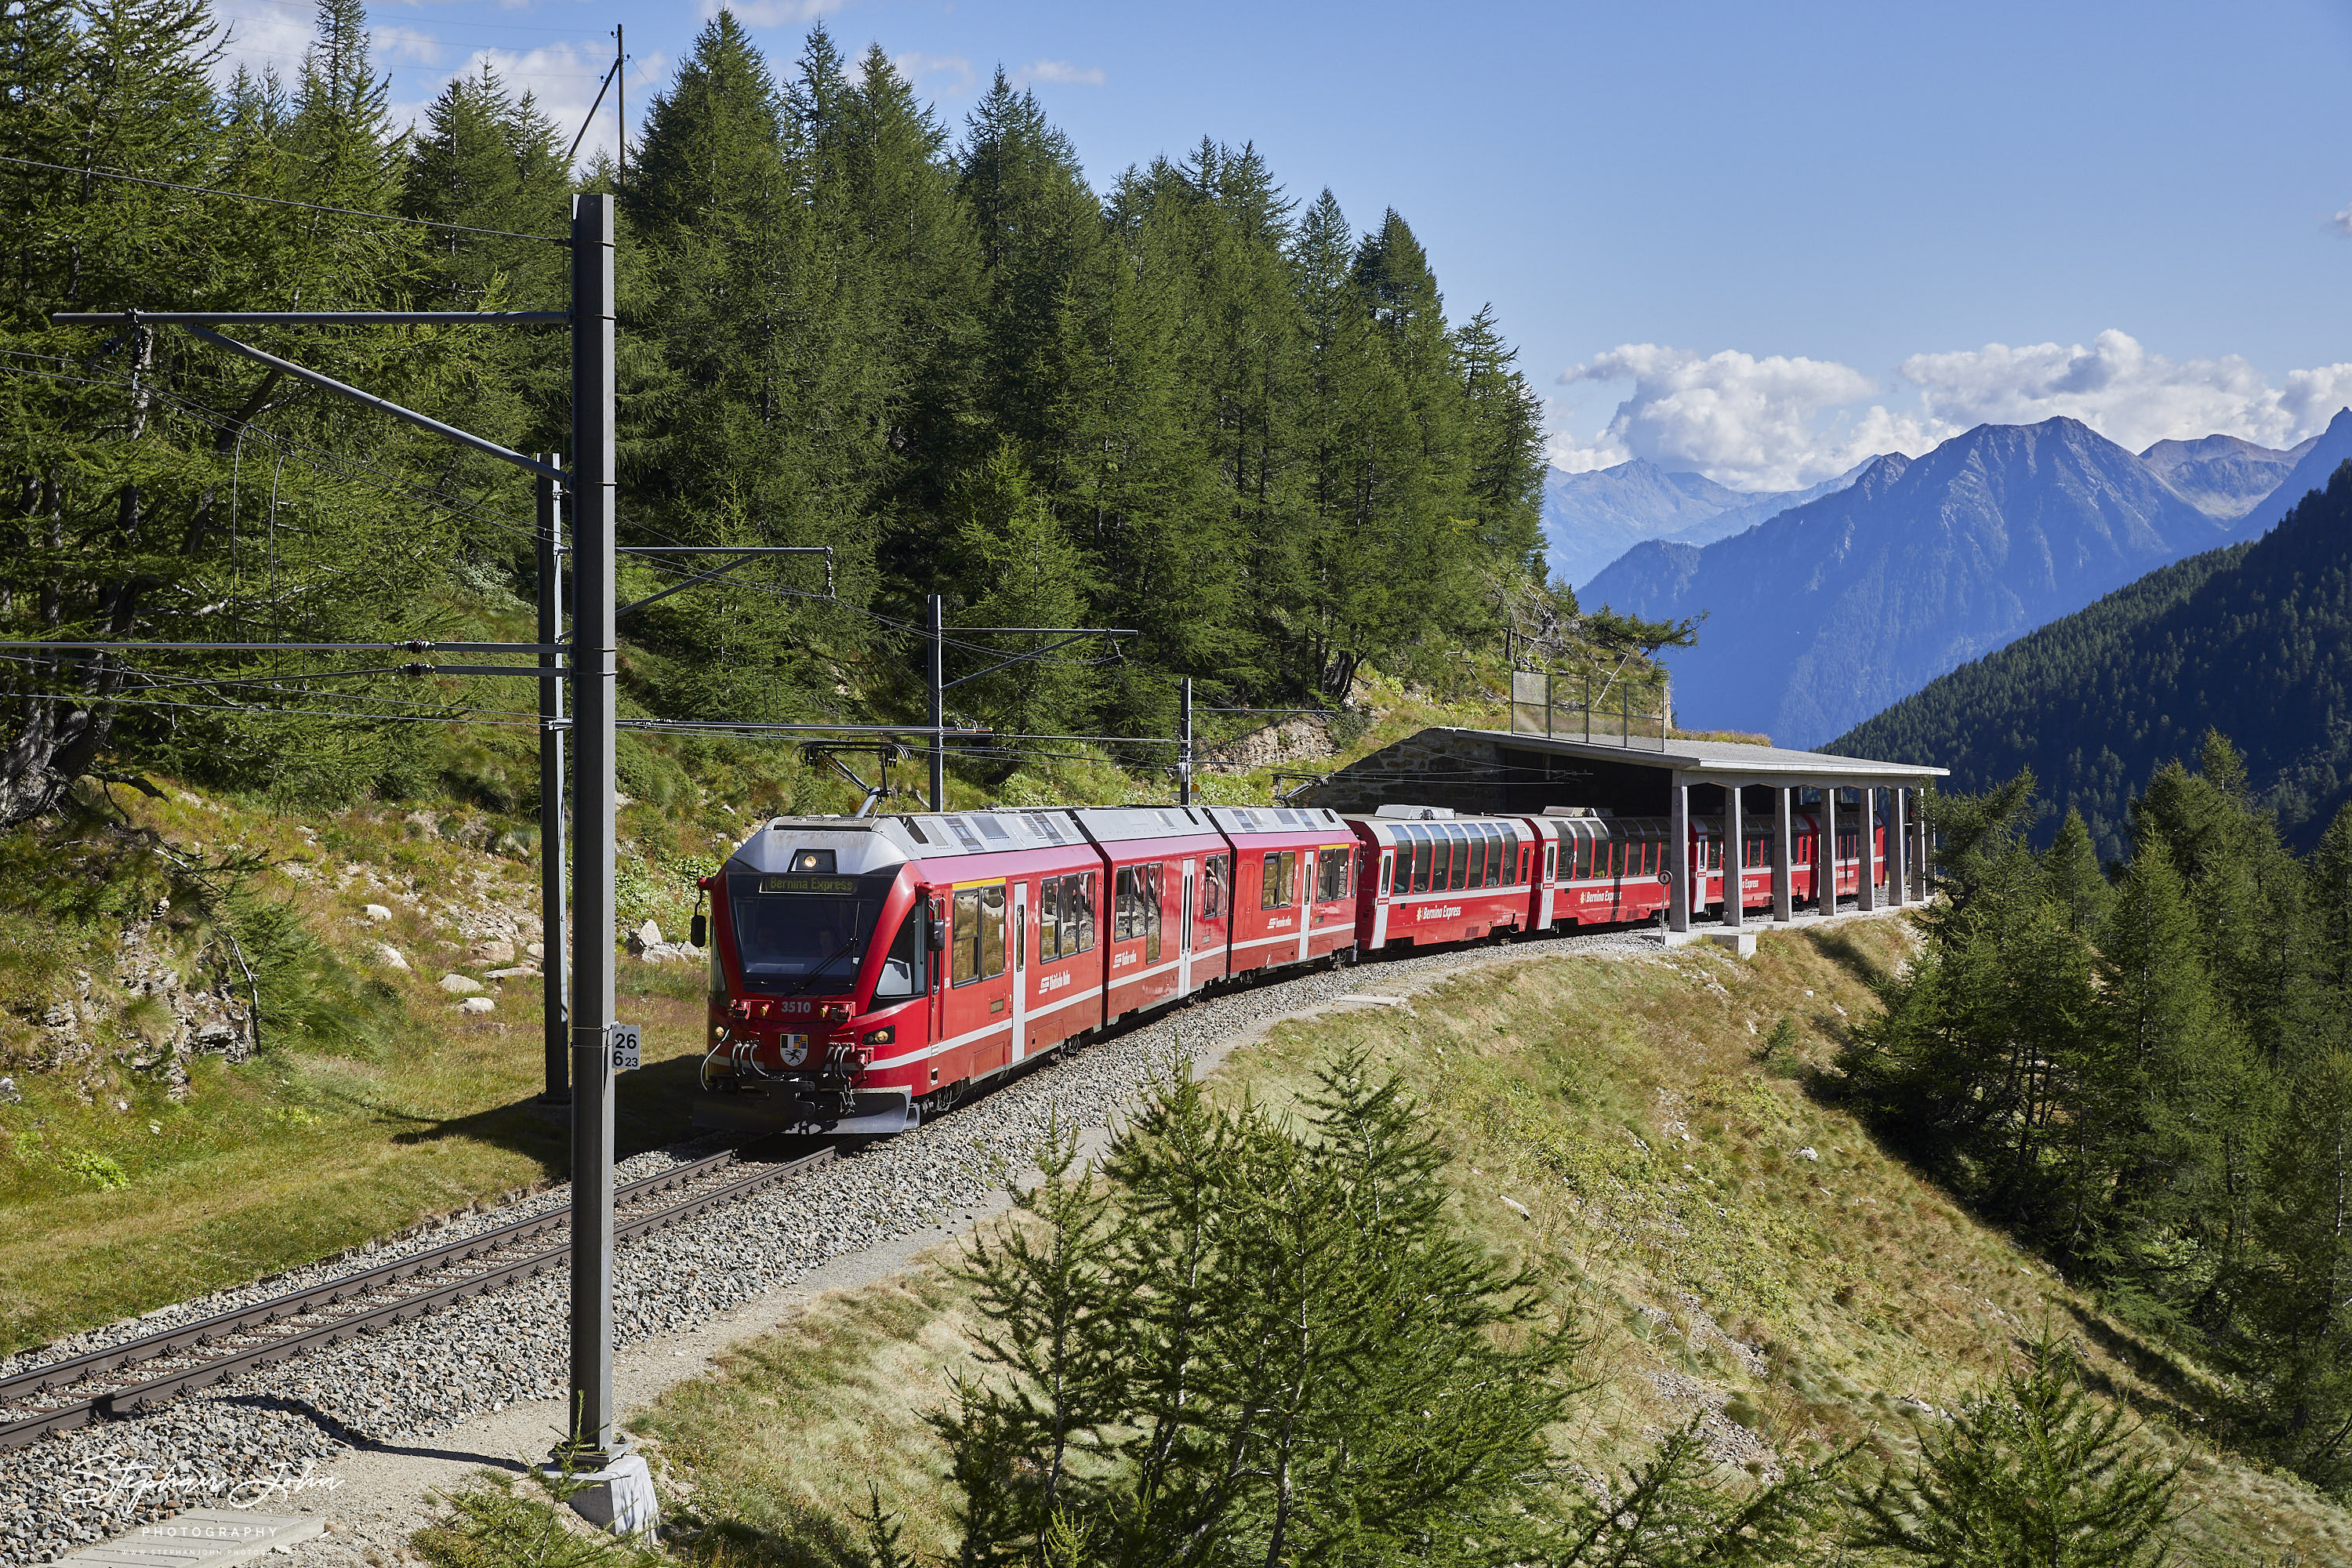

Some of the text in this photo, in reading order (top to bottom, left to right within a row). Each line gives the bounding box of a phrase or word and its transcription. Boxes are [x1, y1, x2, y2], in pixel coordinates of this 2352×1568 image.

[771, 877, 853, 891] Bernina Express
[1423, 905, 1461, 920] Bernina Express
[781, 1000, 811, 1013] 3510
[614, 1033, 637, 1050] 26
[613, 1051, 638, 1067] 6 23
